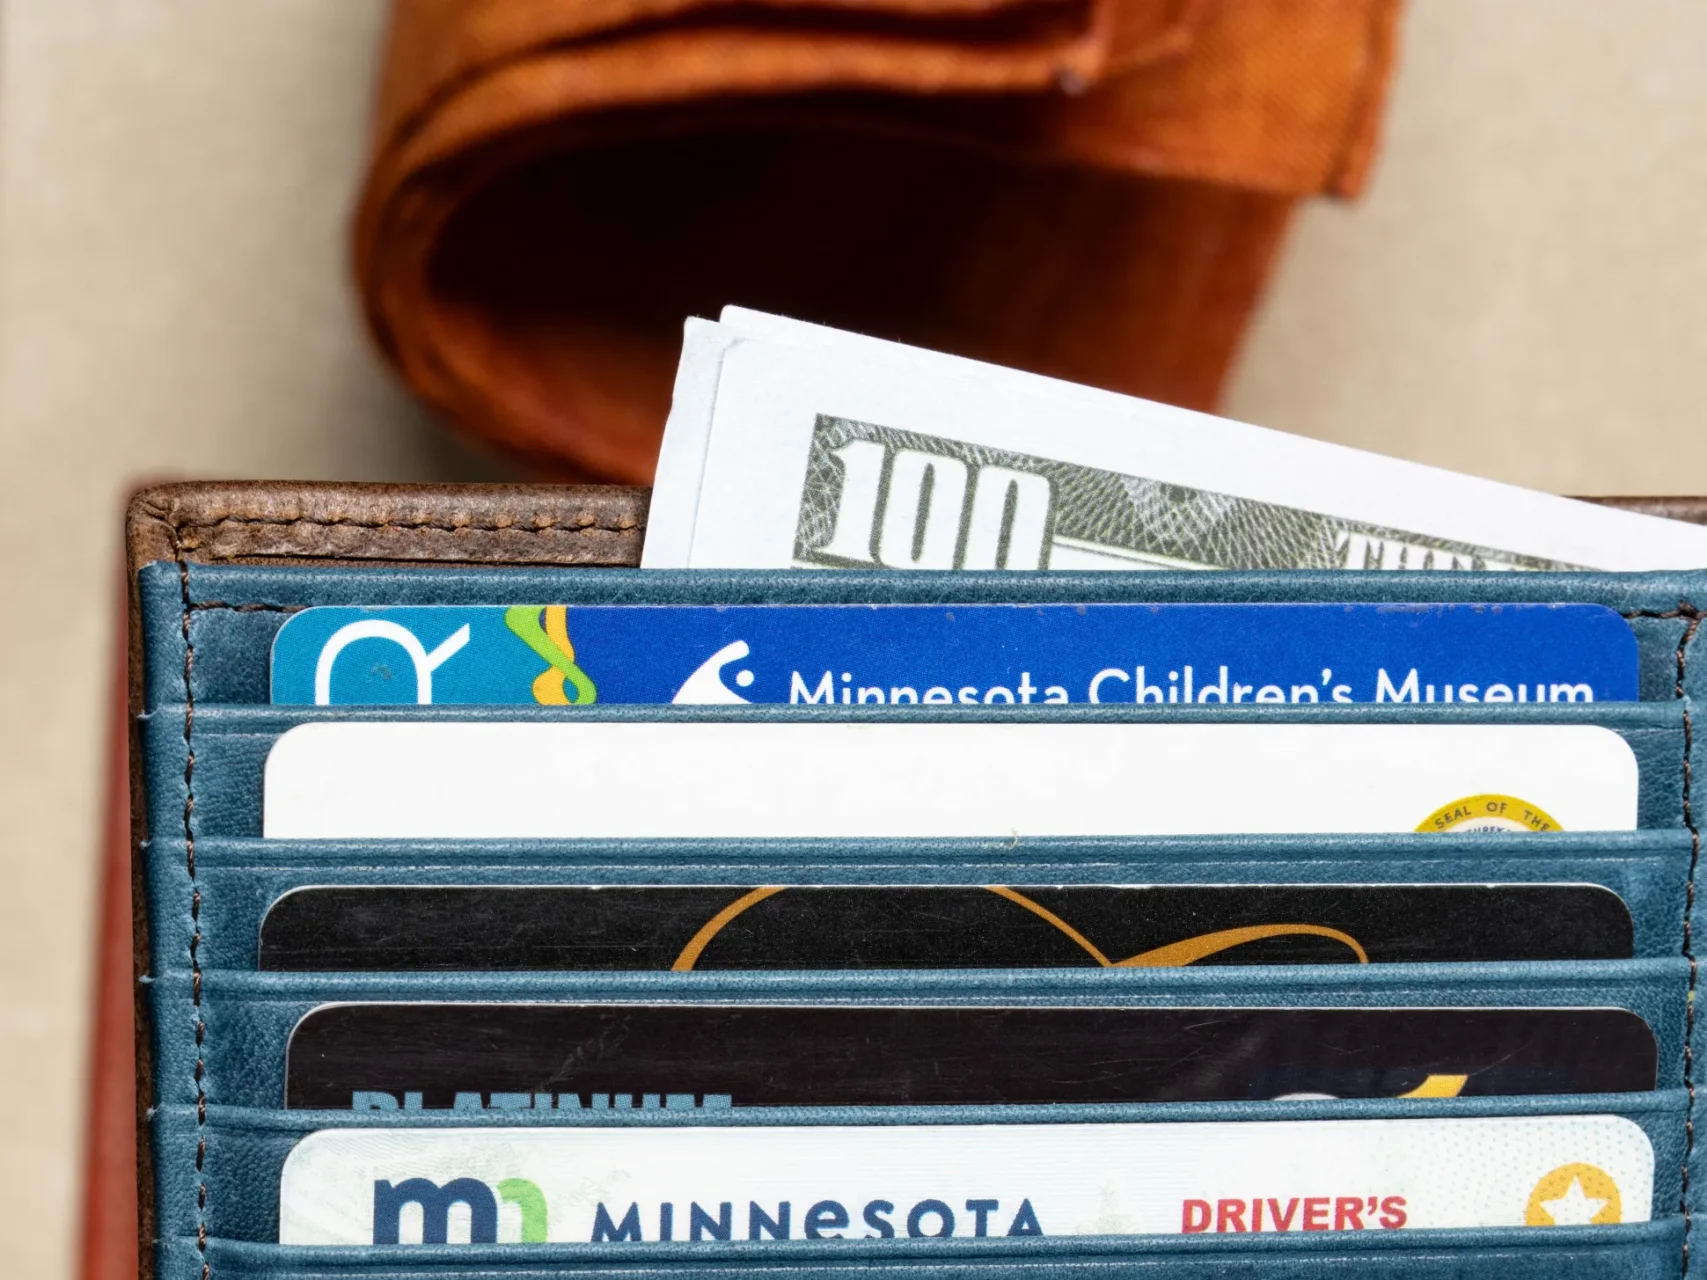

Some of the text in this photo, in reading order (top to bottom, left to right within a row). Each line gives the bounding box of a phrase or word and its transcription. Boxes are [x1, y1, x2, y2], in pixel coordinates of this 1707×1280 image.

[812, 439, 1050, 570] 100
[790, 670, 1069, 704] Minnesota
[1375, 668, 1594, 703] Museum
[1434, 801, 1551, 832] SEAL OF THE
